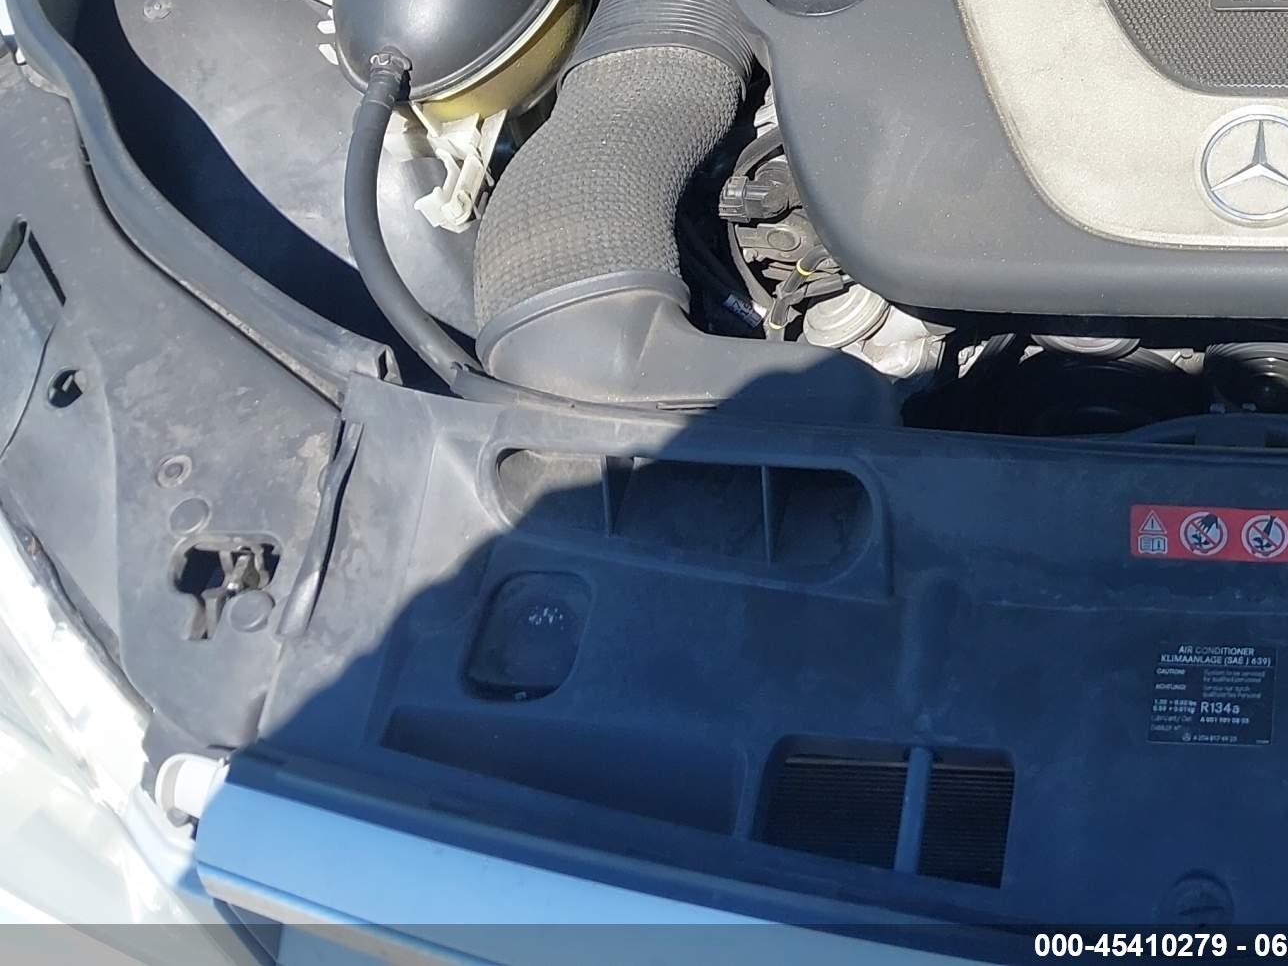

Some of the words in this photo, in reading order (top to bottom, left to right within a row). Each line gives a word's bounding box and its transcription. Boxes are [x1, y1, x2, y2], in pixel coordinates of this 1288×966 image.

[1178, 645, 1193, 655] AIR
[1195, 646, 1255, 656] CONDITIONER
[1161, 654, 1222, 665] KLIMAANLAGE
[1224, 656, 1244, 666] (SAE
[1251, 657, 1271, 667] 639)
[1200, 701, 1240, 714] R134a
